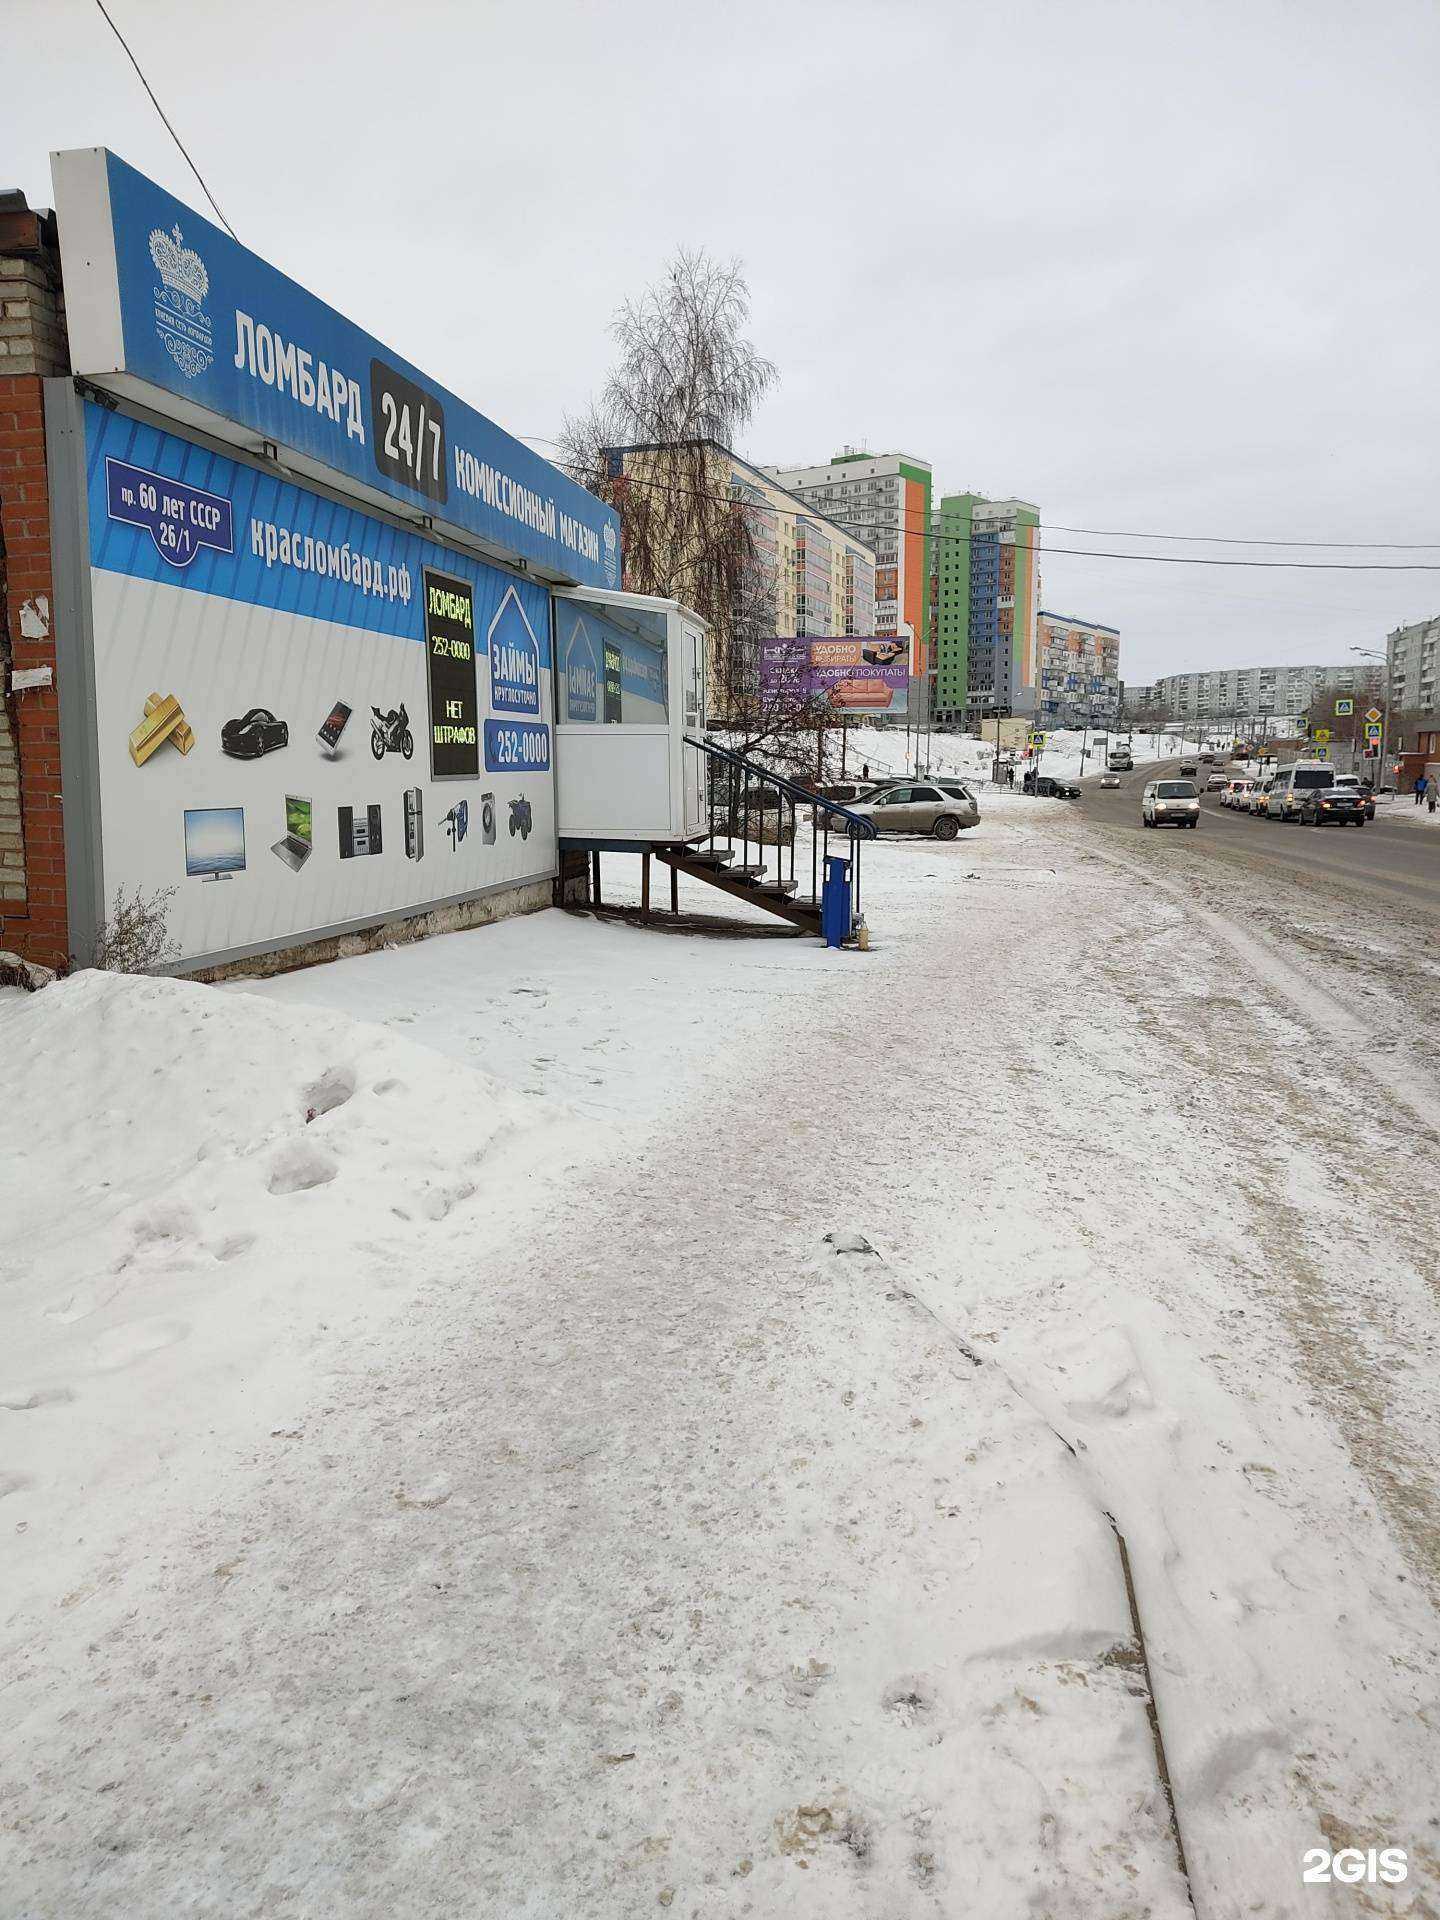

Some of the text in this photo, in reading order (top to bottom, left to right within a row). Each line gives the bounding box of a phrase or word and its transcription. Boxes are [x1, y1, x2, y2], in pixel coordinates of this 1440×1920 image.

[234, 309, 599, 563] ЛОМБАРД 24/7 КОМИССИОННЫЙ МАГАЗИН
[121, 482, 221, 531] пр. 60 лет СССР
[159, 521, 190, 554] 26/1
[251, 518, 411, 606] красломбард.рф
[429, 586, 472, 630] ЛОМБАРД
[432, 636, 471, 660] 252-0000
[493, 641, 536, 686] ЗАЙМЫ
[815, 645, 857, 655] УДОБНО
[446, 700, 463, 719] НЕТ
[434, 725, 476, 744] ШТРАФОВ
[498, 730, 547, 763] 252-0000
